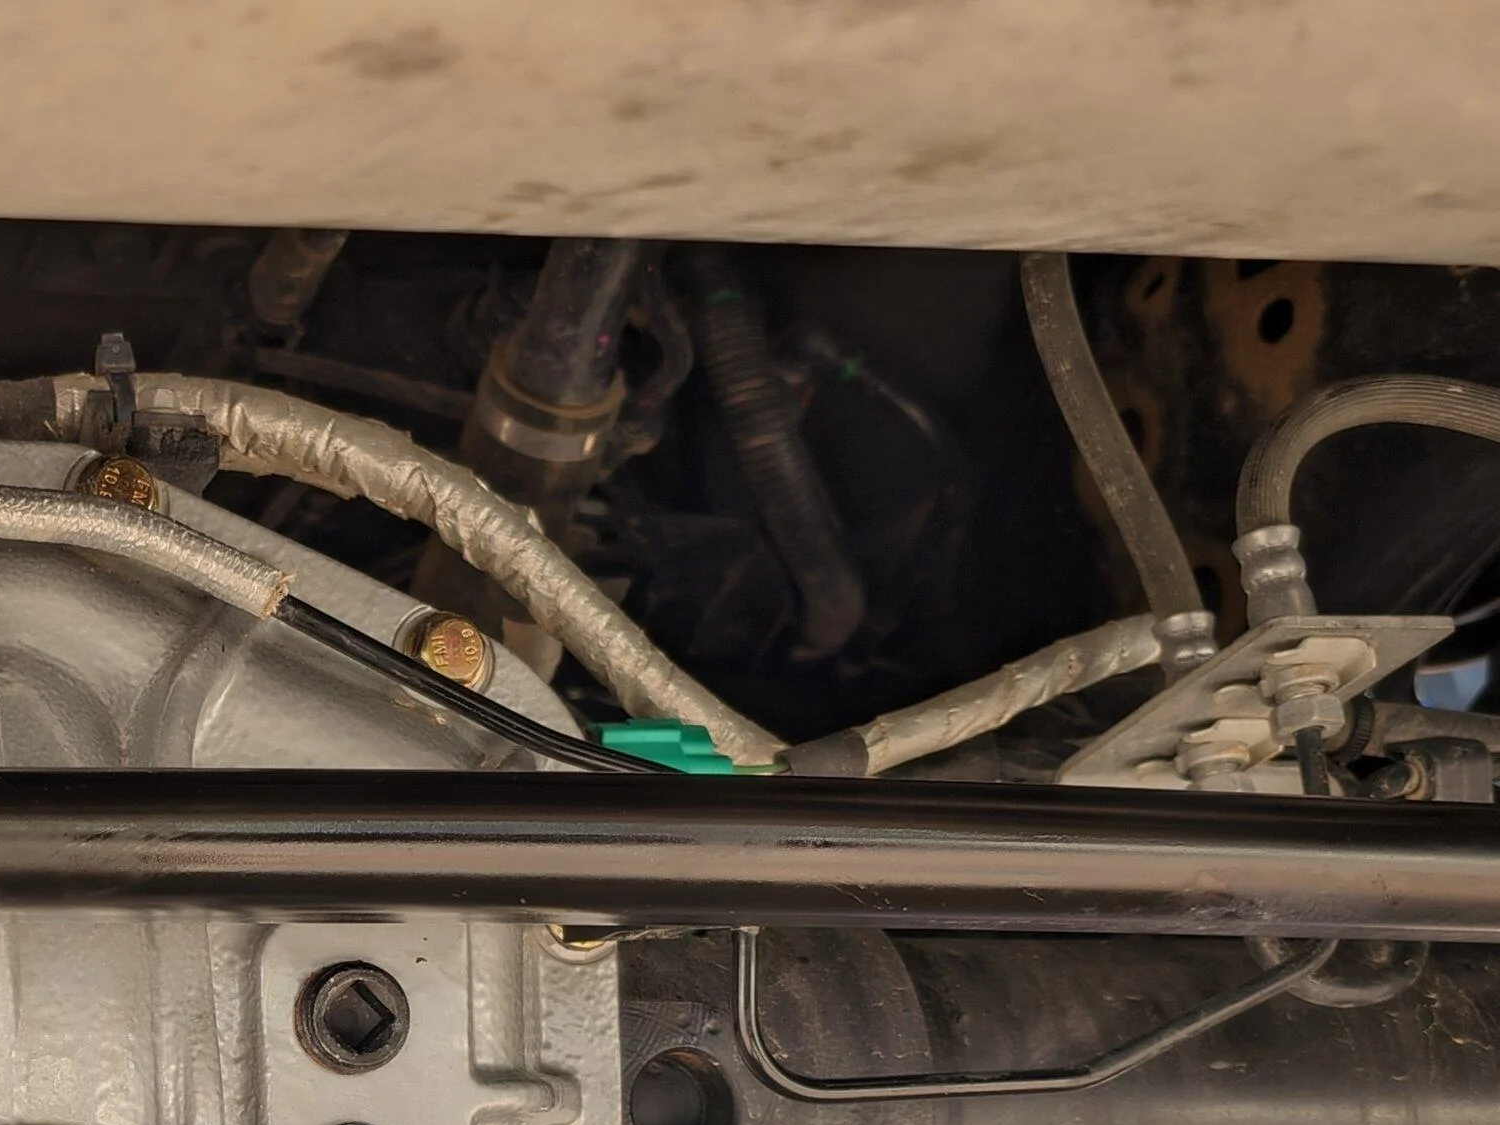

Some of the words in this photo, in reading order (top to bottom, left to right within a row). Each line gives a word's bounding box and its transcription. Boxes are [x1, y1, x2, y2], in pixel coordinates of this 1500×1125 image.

[130, 479, 151, 506] FM
[430, 635, 450, 668] FMI
[461, 628, 479, 664] 10.9
